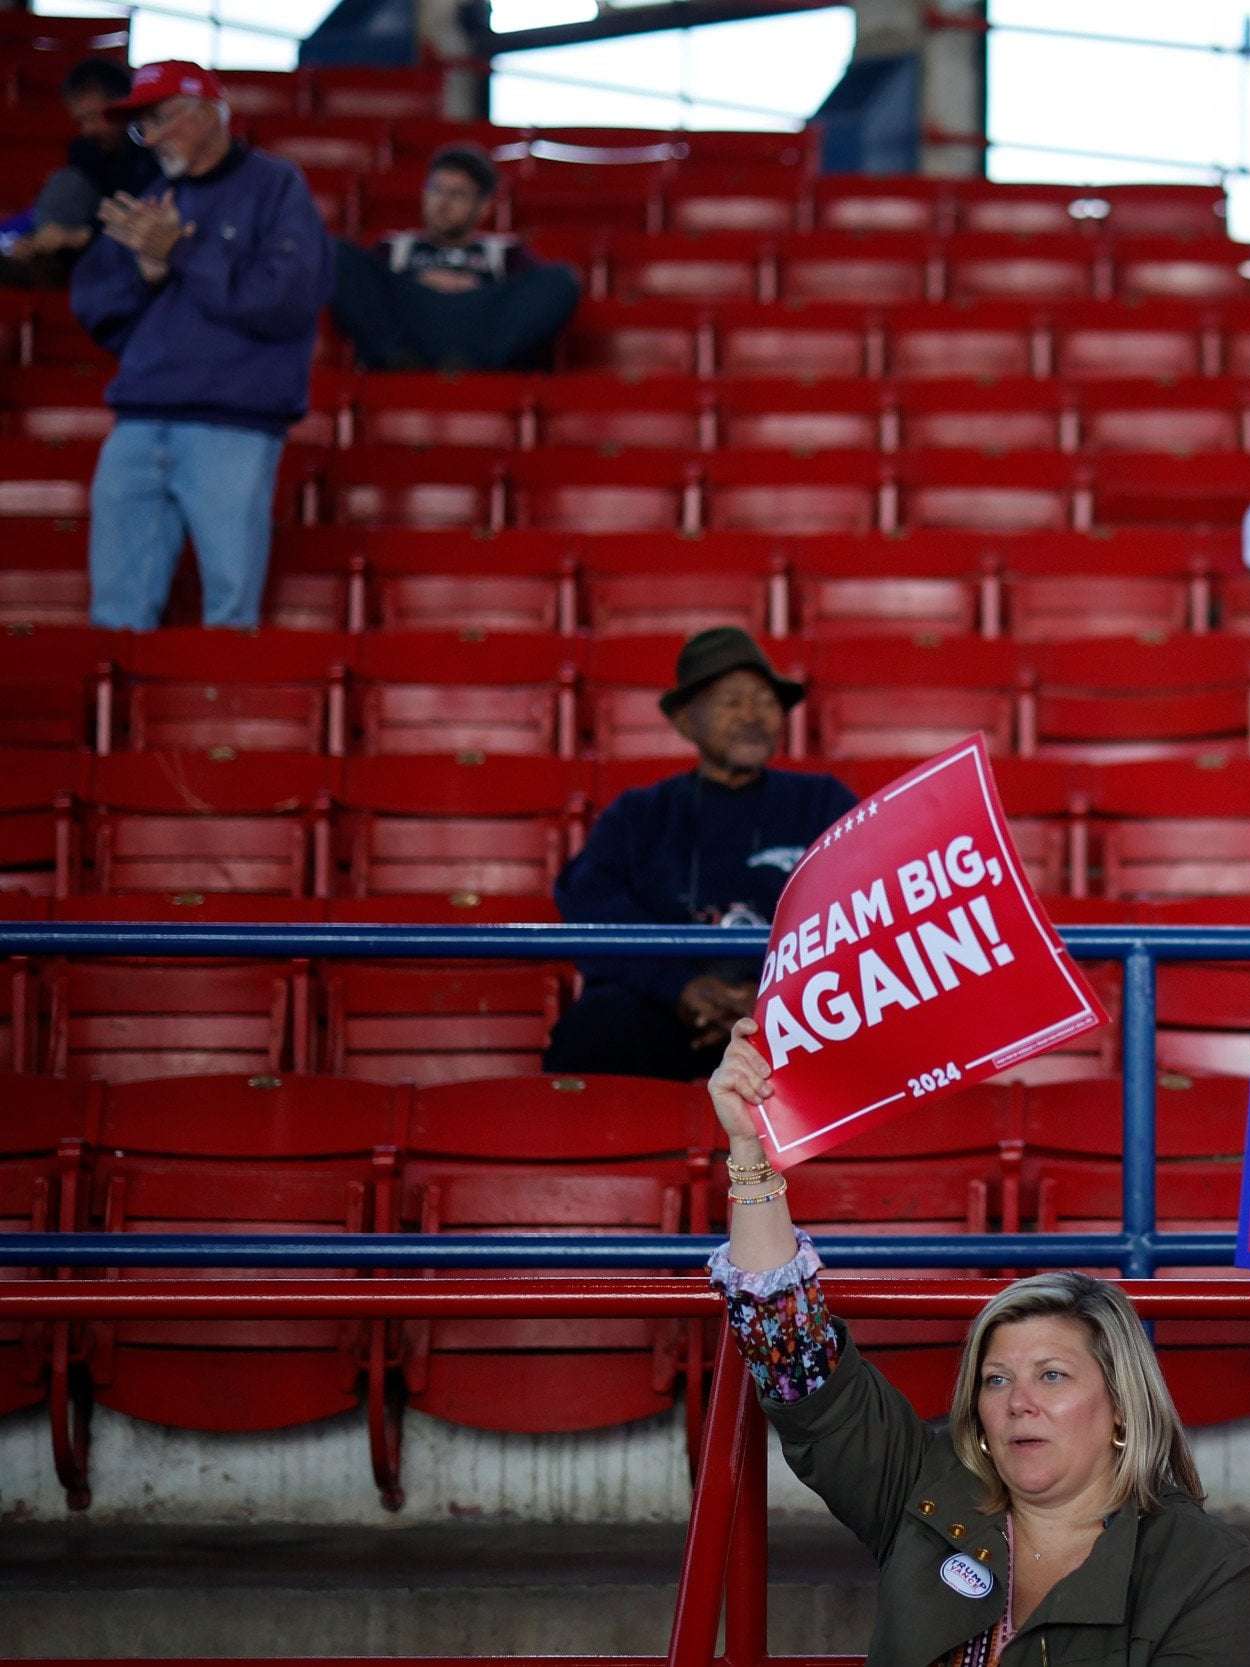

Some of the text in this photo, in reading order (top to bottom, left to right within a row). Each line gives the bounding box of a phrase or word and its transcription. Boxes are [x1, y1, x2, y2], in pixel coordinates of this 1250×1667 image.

[758, 836, 1002, 998] DREAM BIG,
[764, 895, 1015, 1070] AGAIN!
[908, 1063, 961, 1098] 2024
[951, 1559, 987, 1590] TRUMP
